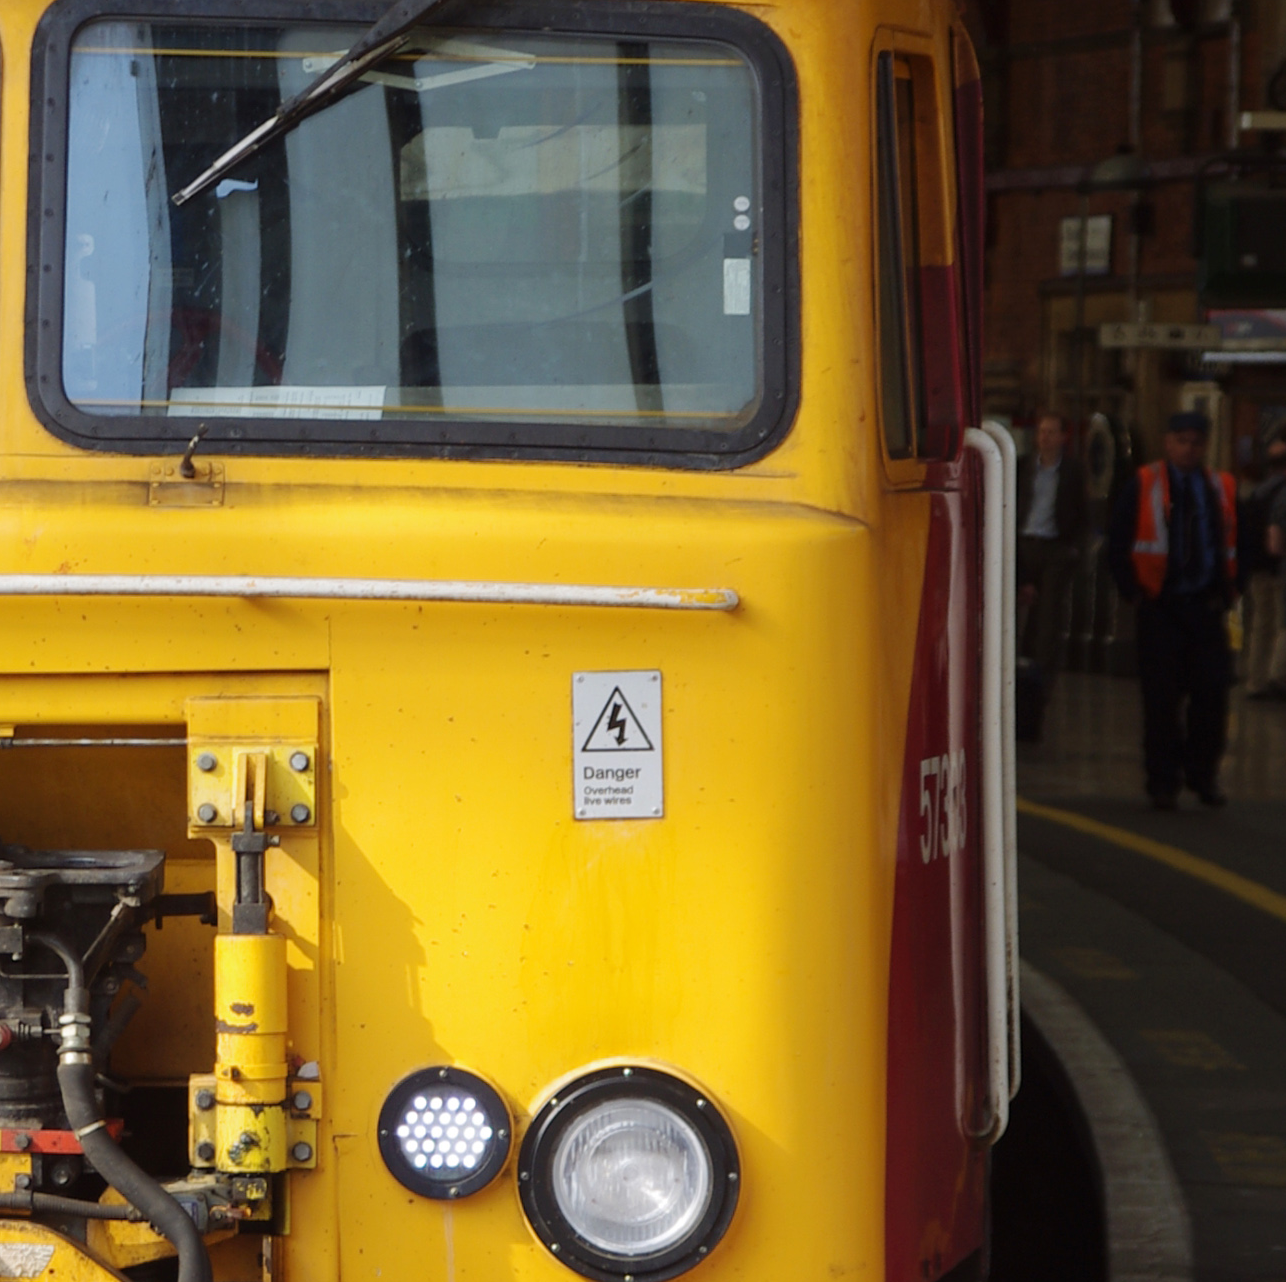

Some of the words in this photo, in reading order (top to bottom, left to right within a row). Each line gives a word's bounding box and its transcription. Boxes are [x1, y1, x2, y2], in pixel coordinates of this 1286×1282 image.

[583, 766, 641, 781] Danger
[583, 785, 634, 795] Overhead
[583, 796, 602, 805] live
[604, 796, 632, 805] wires
